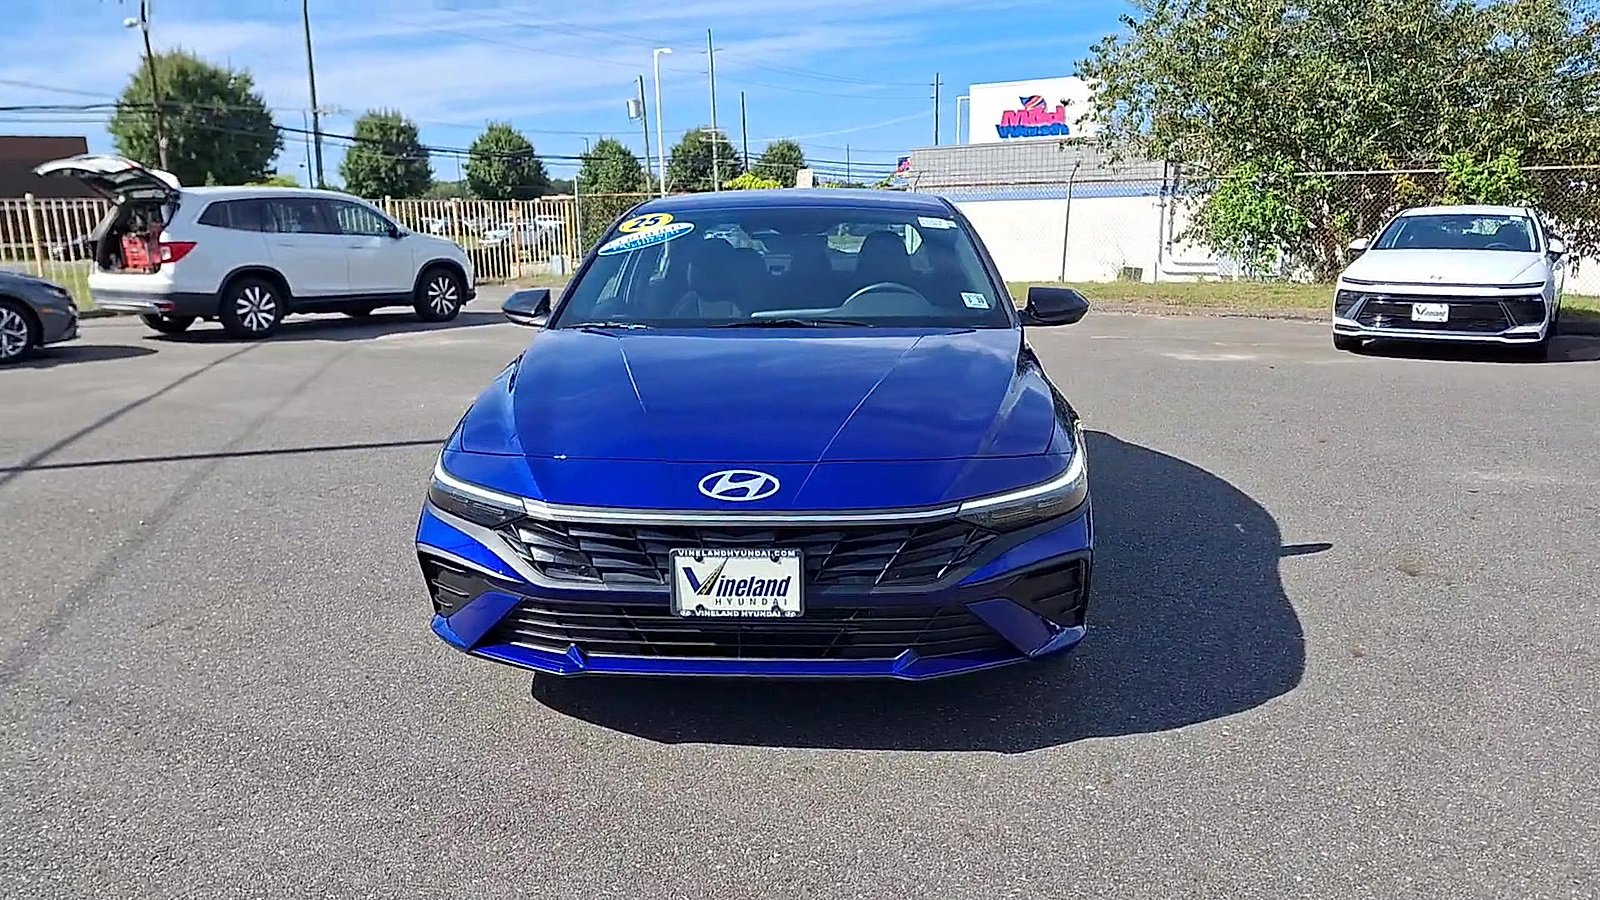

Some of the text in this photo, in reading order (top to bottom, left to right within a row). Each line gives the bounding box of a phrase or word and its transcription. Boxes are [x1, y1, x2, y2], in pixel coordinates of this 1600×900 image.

[682, 557, 792, 597] Vineland
[715, 598, 787, 606] HYUNDAI
[695, 610, 782, 618] VINELAND HYUNDAI
